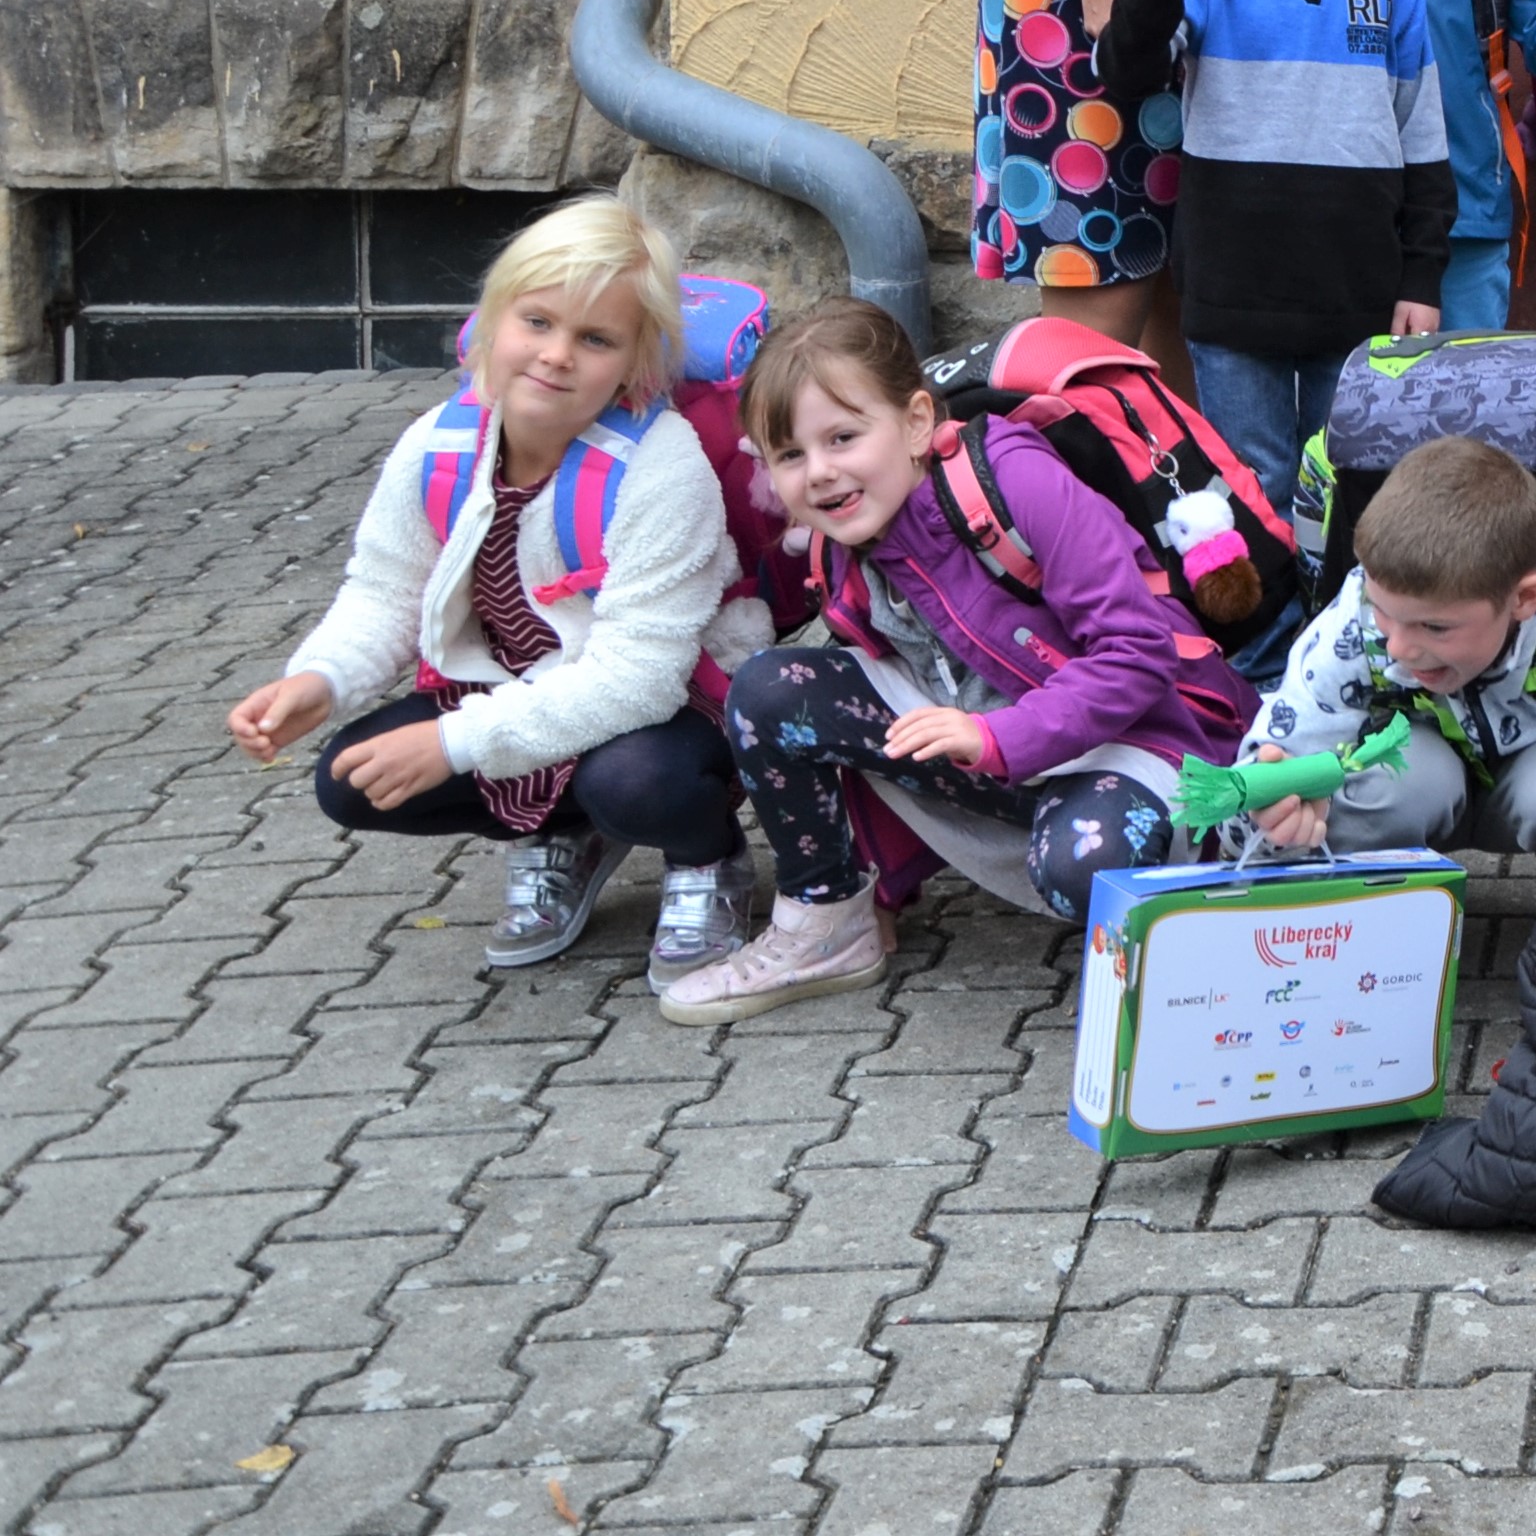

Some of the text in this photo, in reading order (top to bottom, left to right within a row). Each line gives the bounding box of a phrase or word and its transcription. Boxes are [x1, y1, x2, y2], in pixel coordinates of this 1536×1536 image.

[1271, 920, 1353, 945] Liberecký
[1305, 940, 1338, 961] kraj
[1382, 972, 1423, 986] GORDIC
